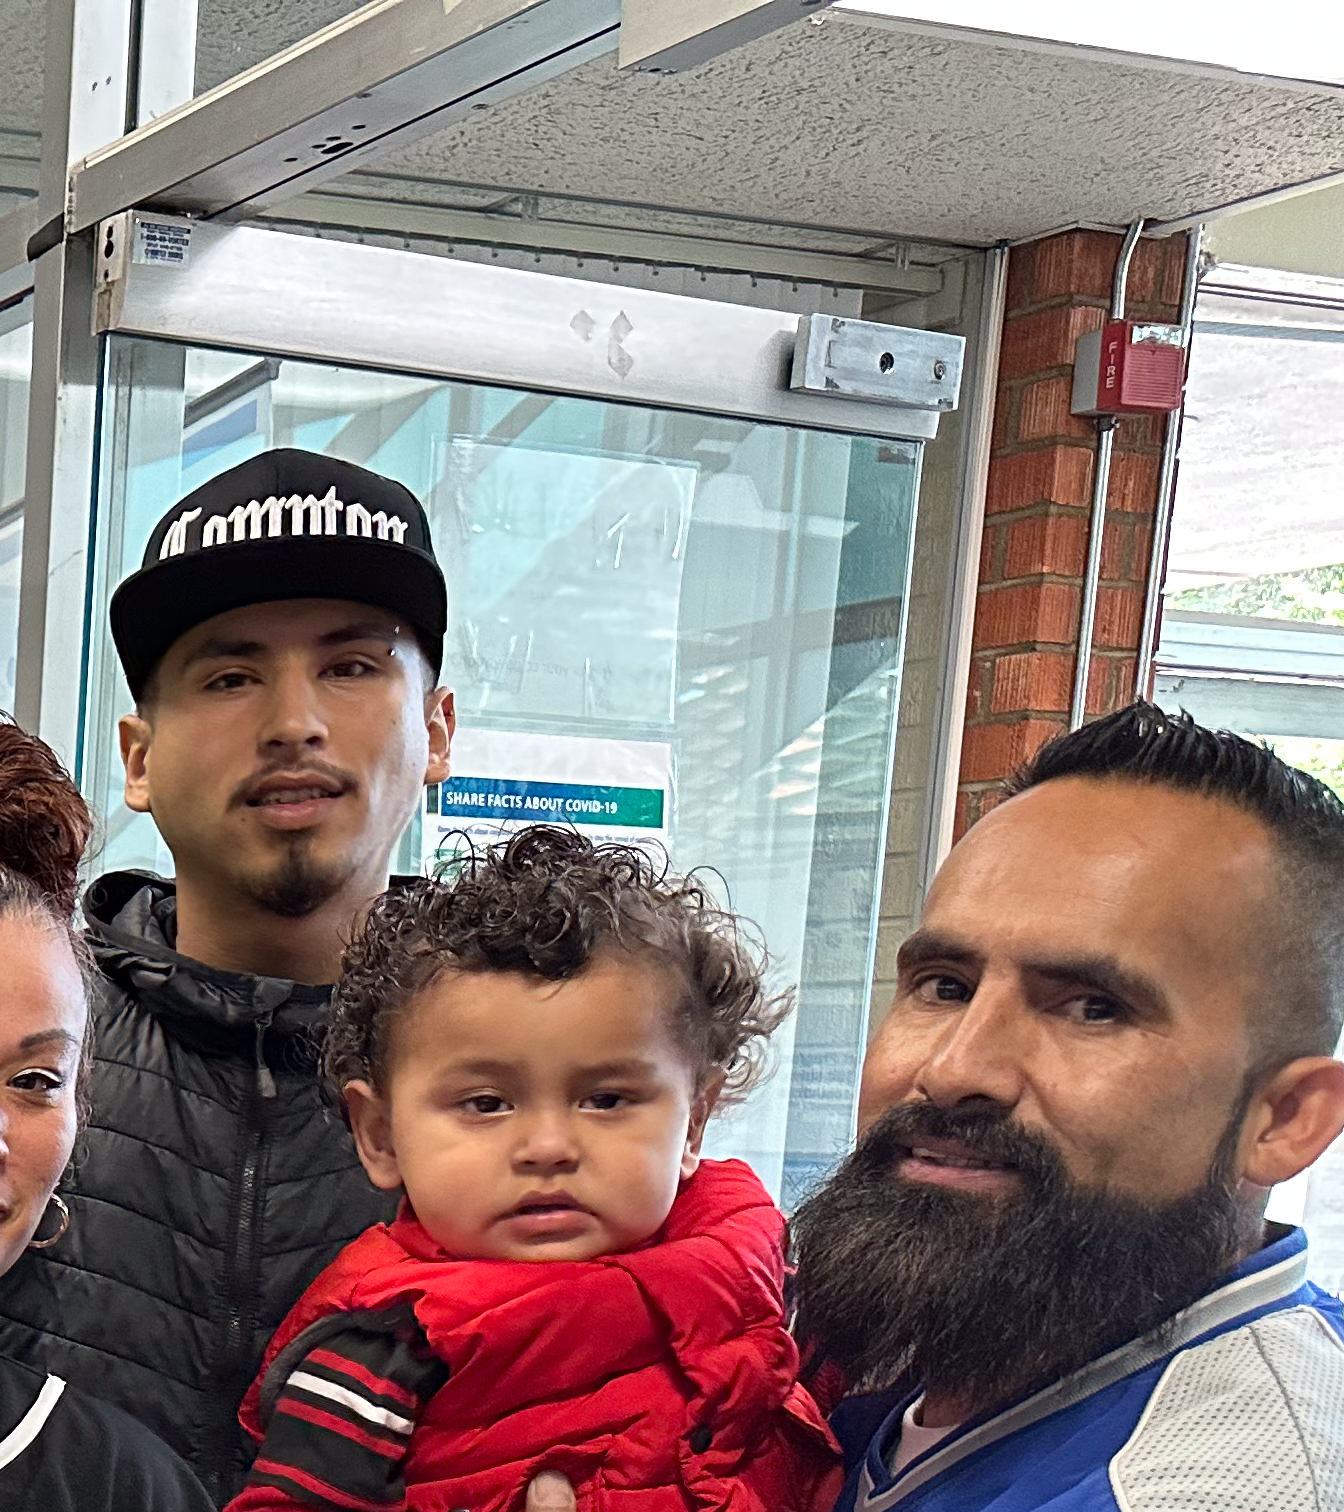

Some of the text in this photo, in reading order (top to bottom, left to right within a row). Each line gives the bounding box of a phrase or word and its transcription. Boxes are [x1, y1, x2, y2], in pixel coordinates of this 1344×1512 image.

[1105, 341, 1119, 389] FIRE
[446, 791, 618, 814] SHARE FACTS ABOUT COVID-19
